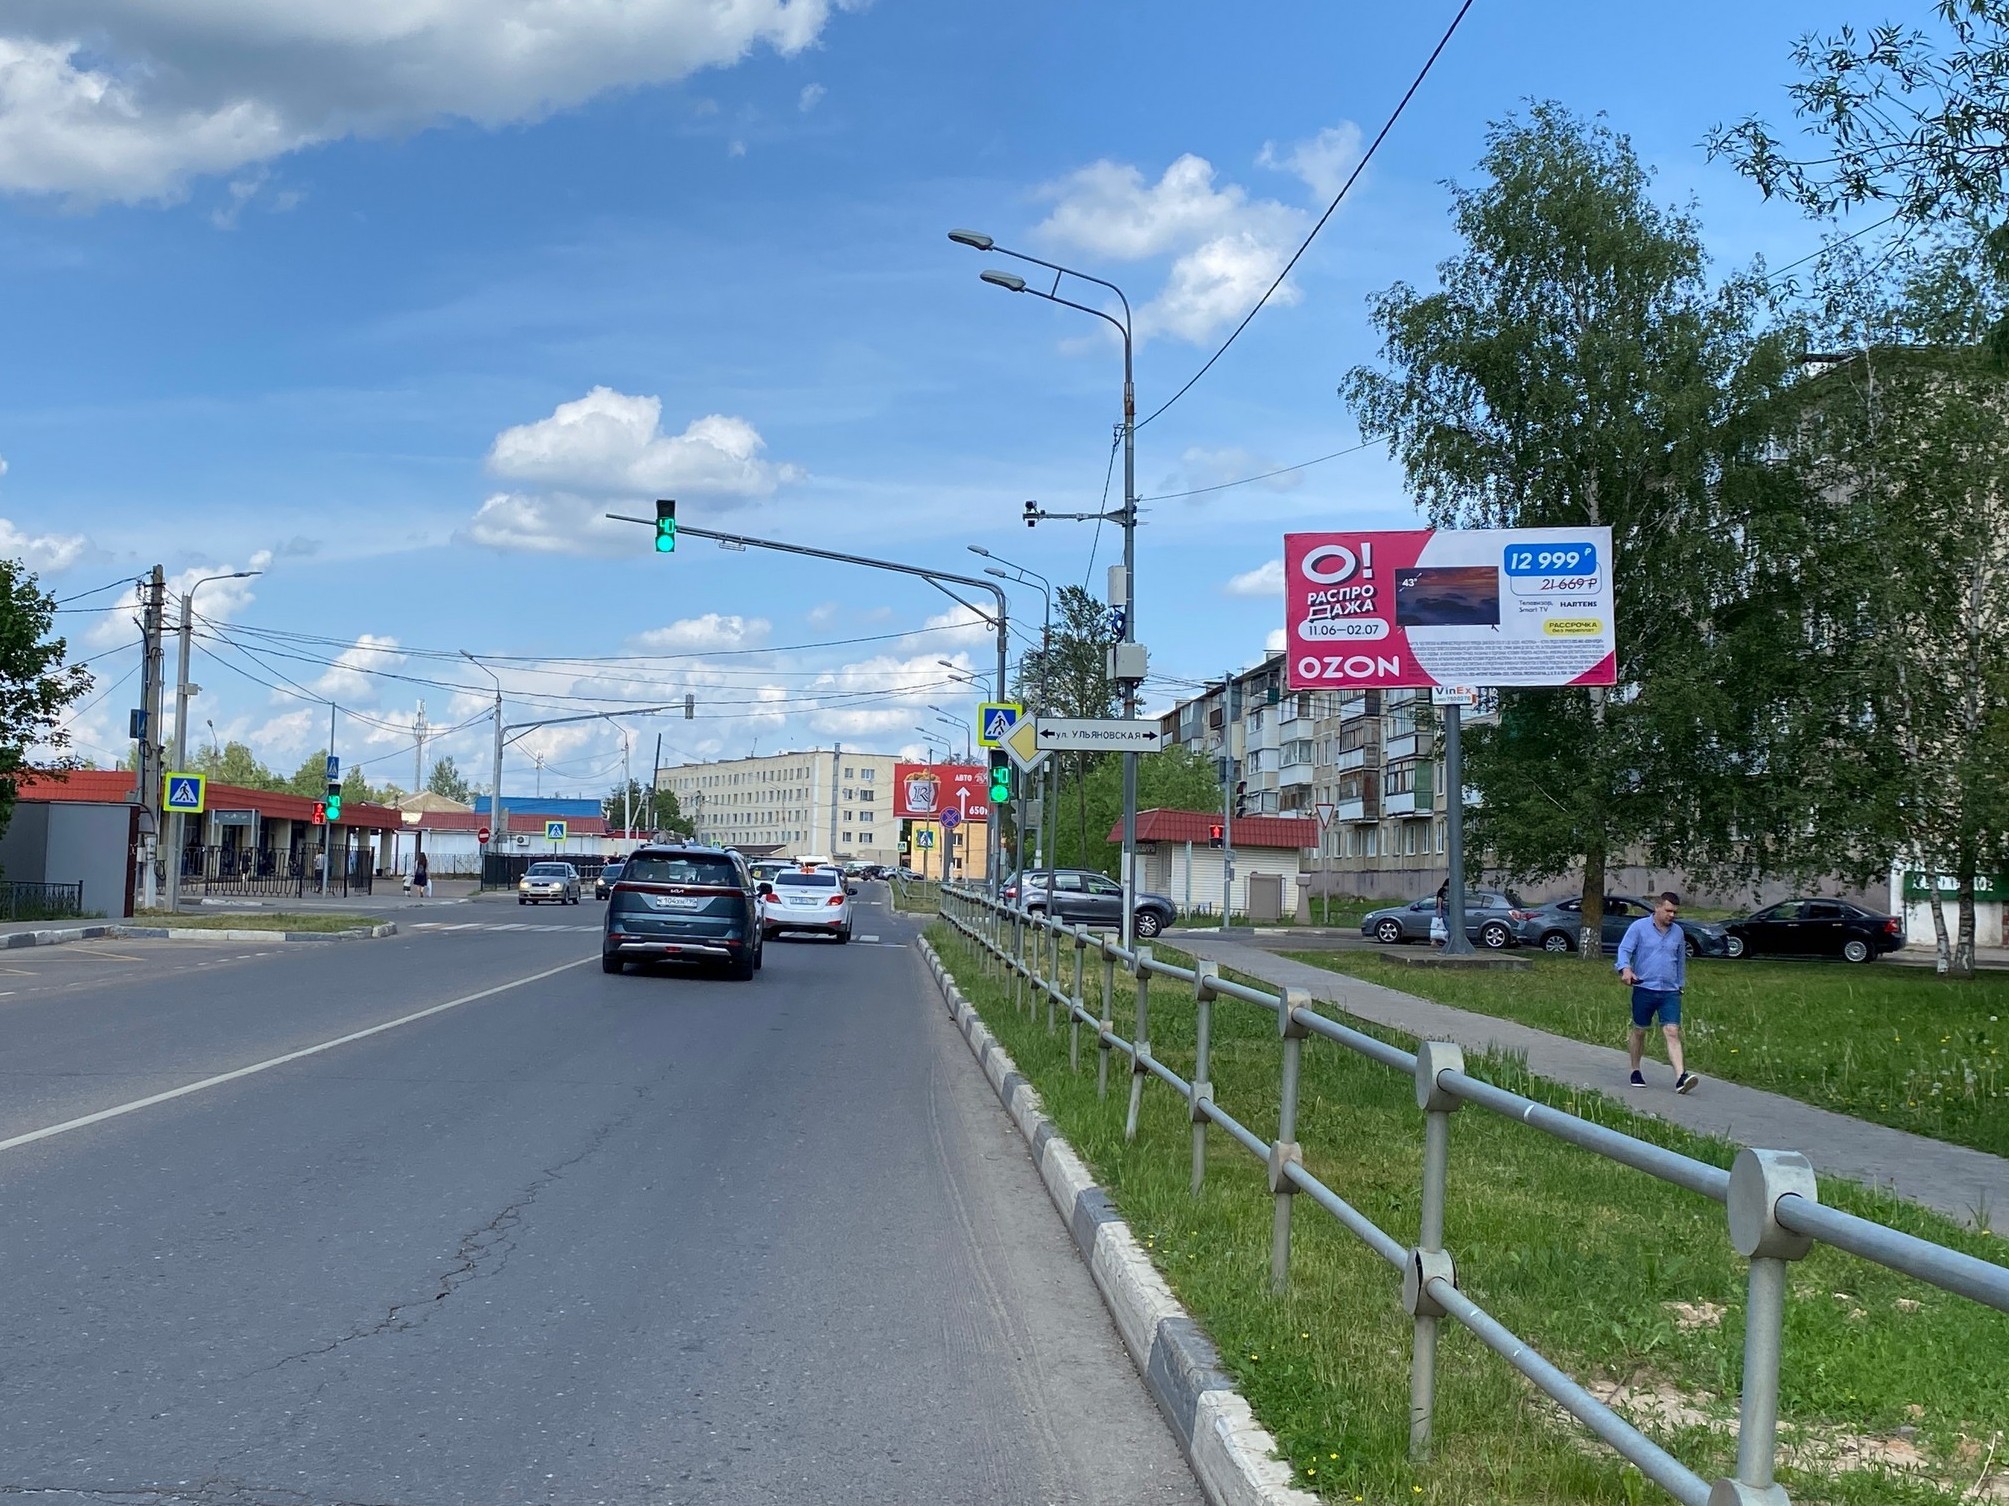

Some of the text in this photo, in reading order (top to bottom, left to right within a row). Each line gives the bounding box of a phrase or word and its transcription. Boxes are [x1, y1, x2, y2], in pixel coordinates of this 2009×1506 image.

[659, 519, 675, 533] 40
[1511, 552, 1533, 570] 12
[1538, 551, 1580, 570] 999
[1558, 577, 1584, 590] 669
[1307, 584, 1375, 605] РАСПРО
[1306, 599, 1375, 621] ДАЖА
[1298, 655, 1400, 679] OZON
[1436, 686, 1472, 695] VinEx
[1056, 730, 1141, 740] ул. УЛЬЯНОВСКАЯ
[955, 774, 972, 782] АВТО
[993, 768, 1009, 784] 40
